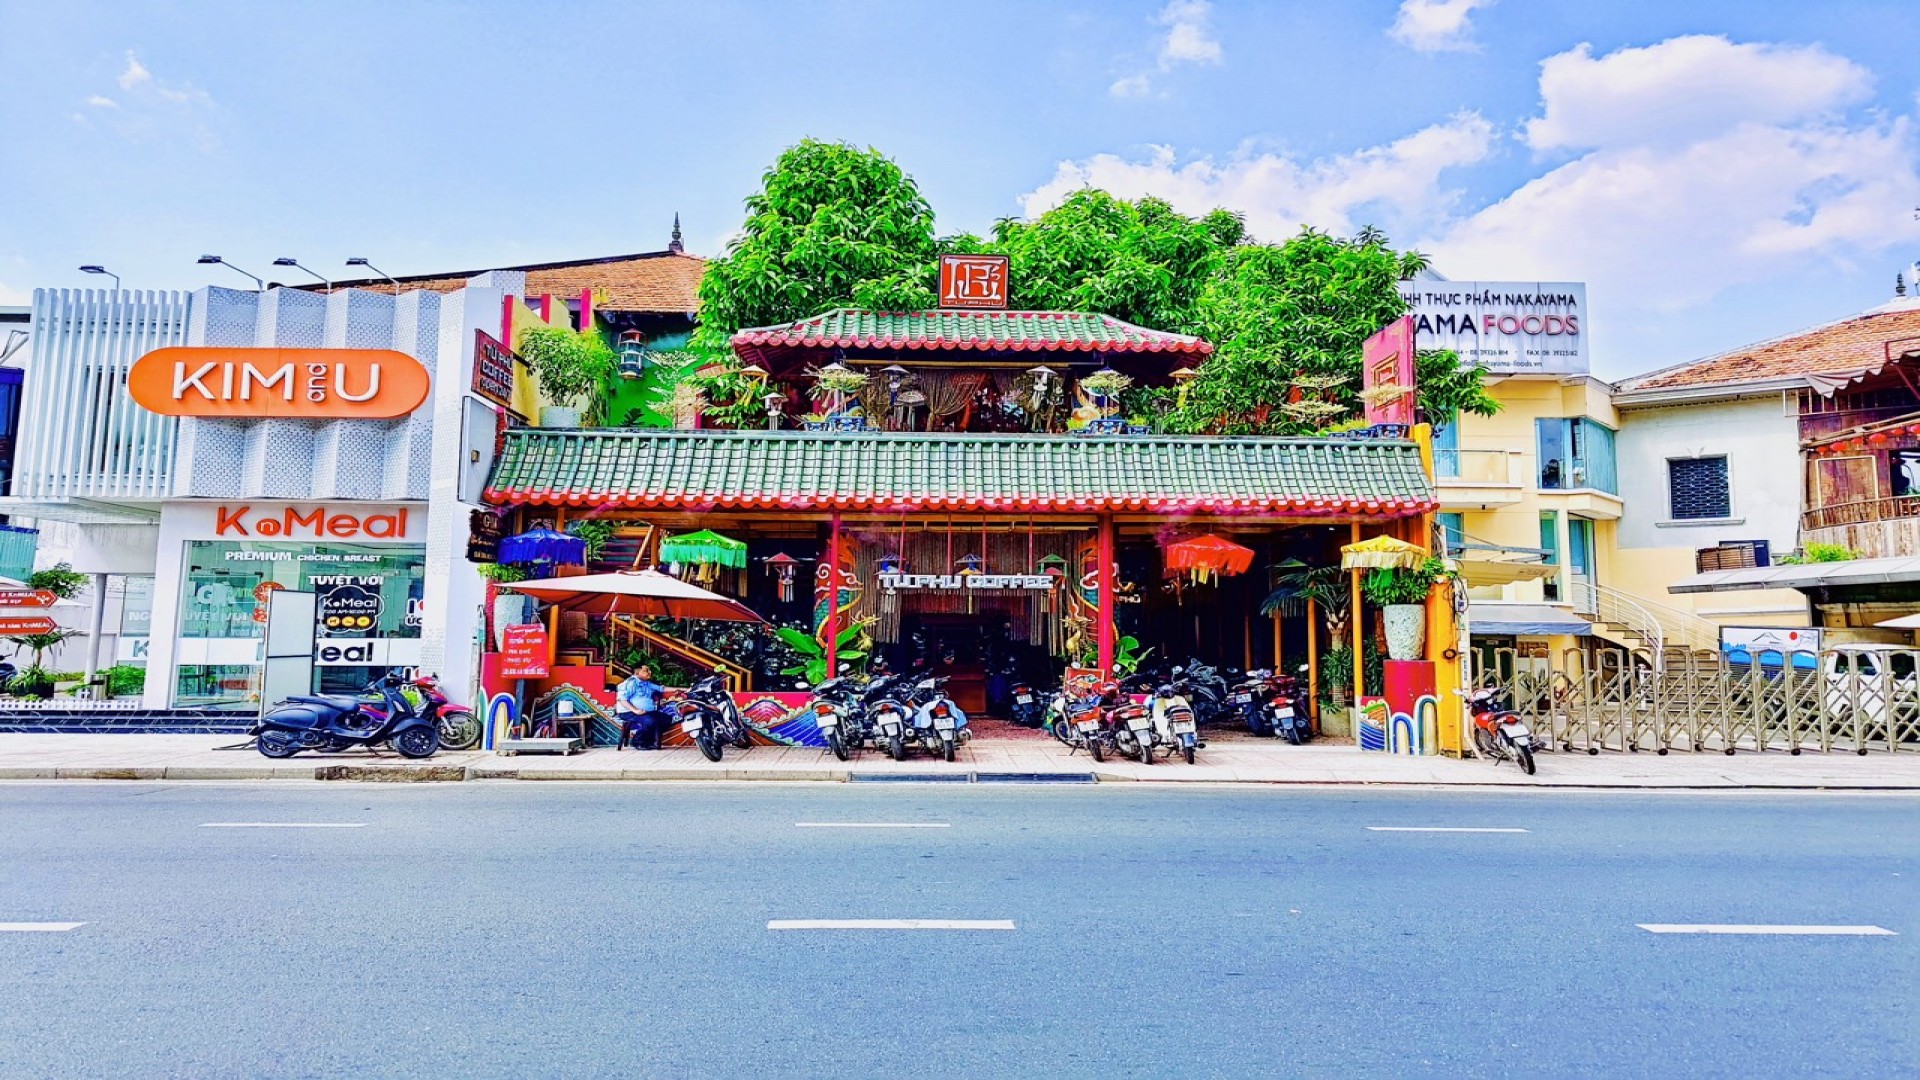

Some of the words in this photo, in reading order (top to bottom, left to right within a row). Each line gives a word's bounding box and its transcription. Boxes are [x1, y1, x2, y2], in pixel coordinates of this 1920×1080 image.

[1426, 294, 1461, 308] THỰC
[1465, 289, 1500, 305] PHẨM
[1505, 293, 1577, 306] NAKAYAMA
[1483, 314, 1579, 336] FOODS
[173, 361, 295, 400] KIM
[305, 363, 327, 402] and
[334, 363, 381, 402] U
[224, 551, 291, 561] PREMIUM
[308, 573, 354, 587] TUYỆT
[966, 574, 1053, 589] COFFEE
[315, 641, 374, 662] eal
